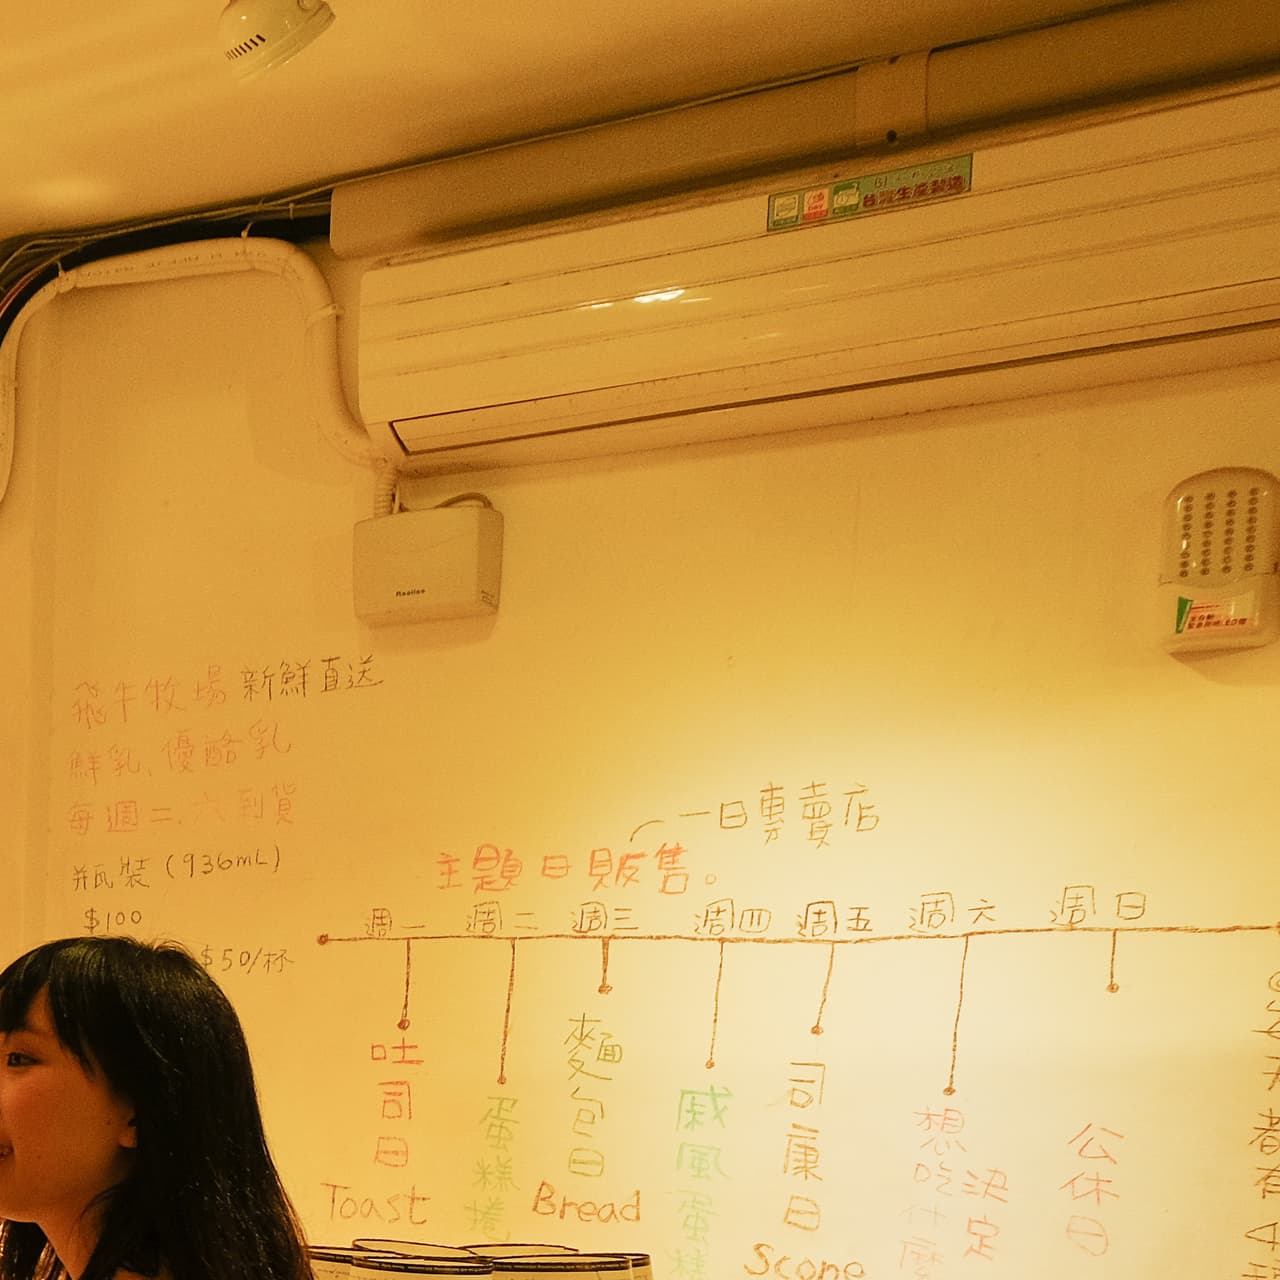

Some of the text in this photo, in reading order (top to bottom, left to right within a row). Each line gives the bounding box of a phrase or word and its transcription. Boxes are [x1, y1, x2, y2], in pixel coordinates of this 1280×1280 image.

[83, 908, 143, 935] $100
[465, 900, 539, 935] 週二
[570, 901, 639, 934] 週三
[693, 897, 771, 937] 週四
[796, 900, 874, 938] 週五
[908, 892, 997, 931] 週六
[1049, 884, 1147, 929] 週日
[369, 1036, 425, 1168] 吐司日
[563, 1012, 624, 1178] 麵包日
[319, 1181, 432, 1227] Toast
[531, 1179, 642, 1225] Bread
[1058, 1122, 1125, 1258] 公休日
